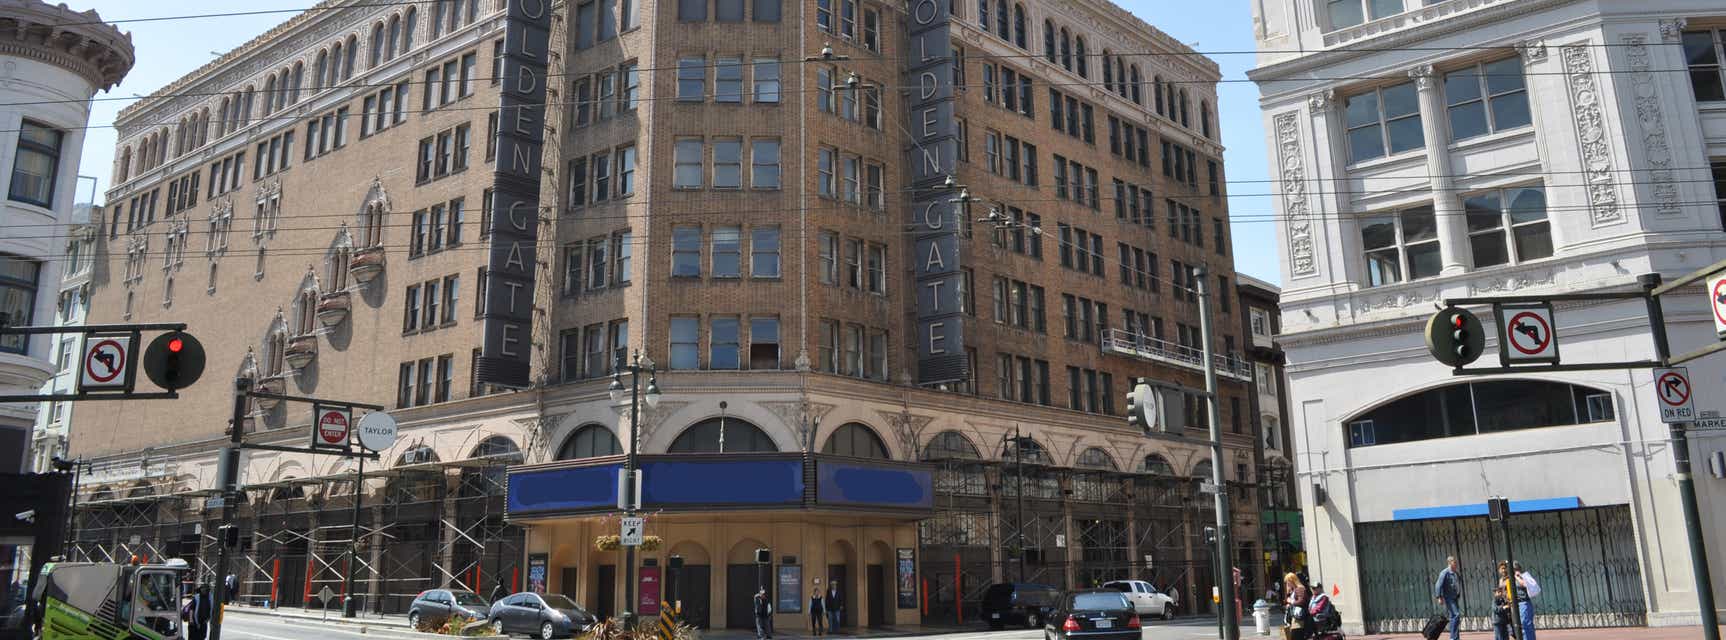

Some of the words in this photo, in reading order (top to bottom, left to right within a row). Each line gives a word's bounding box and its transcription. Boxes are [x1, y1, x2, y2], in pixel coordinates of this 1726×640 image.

[501, 199, 528, 358] GATE
[924, 201, 946, 355] GATE
[1664, 408, 1675, 418] ON
[1676, 407, 1691, 417] RED
[333, 417, 345, 425] NOT
[365, 427, 393, 436] TAYLOR
